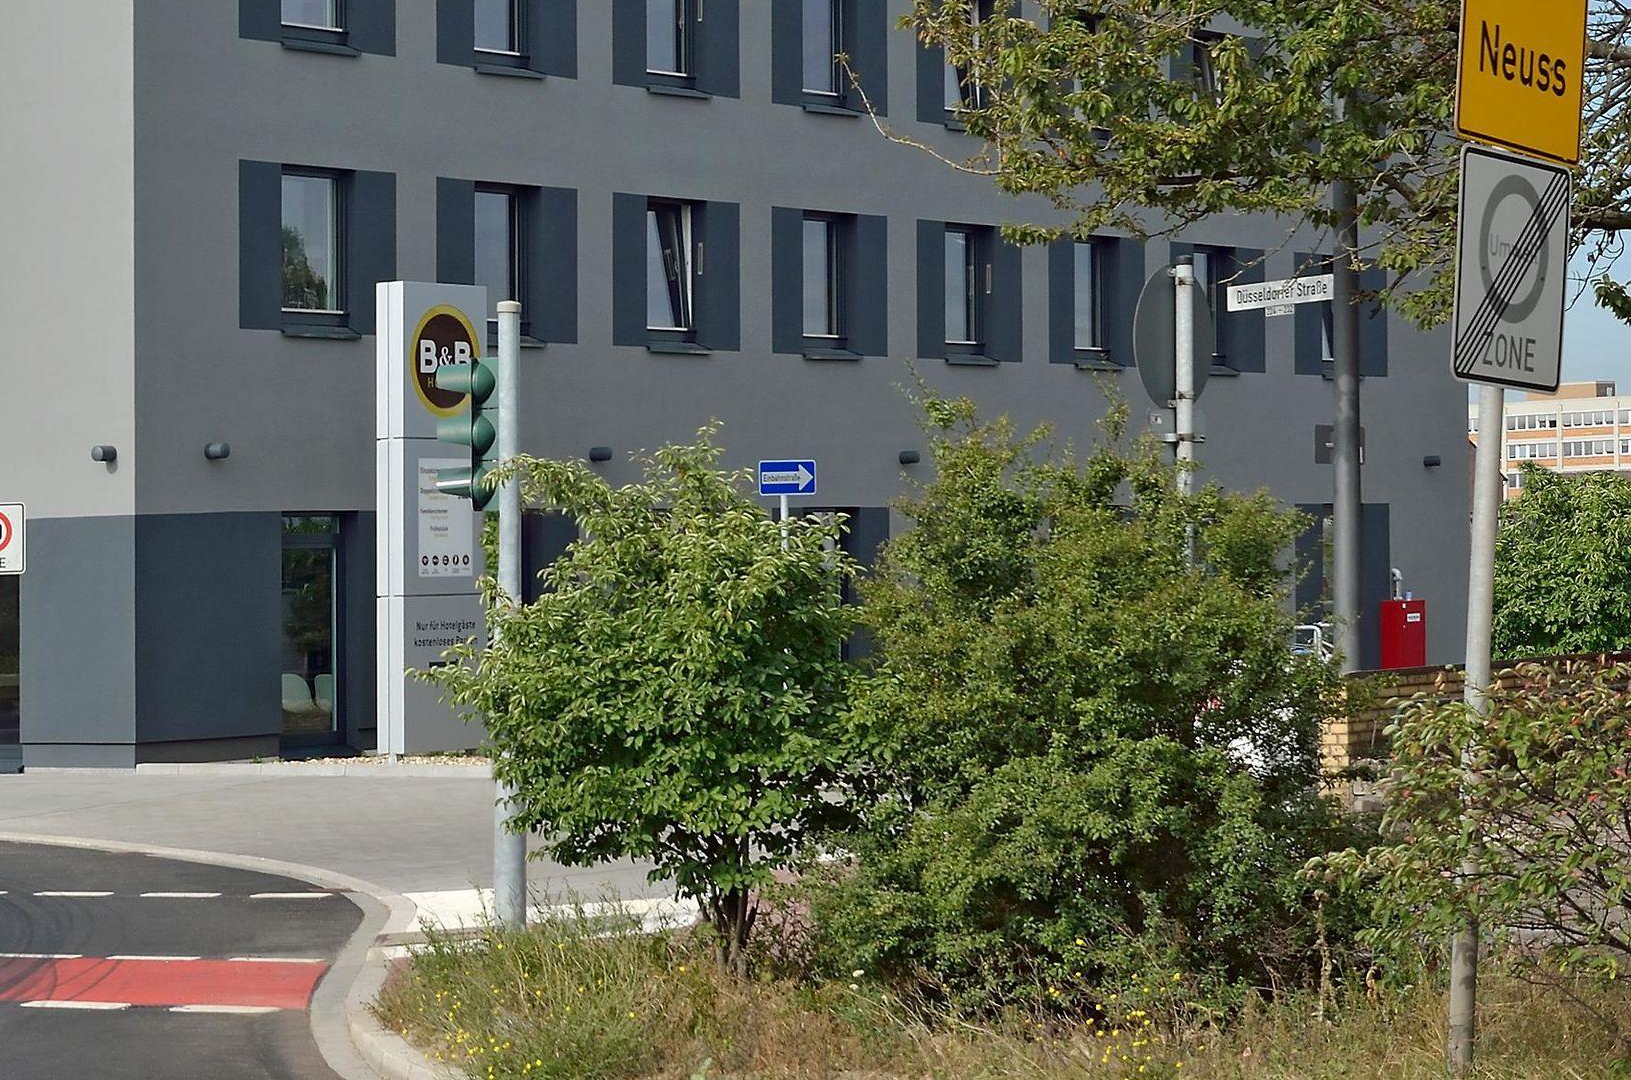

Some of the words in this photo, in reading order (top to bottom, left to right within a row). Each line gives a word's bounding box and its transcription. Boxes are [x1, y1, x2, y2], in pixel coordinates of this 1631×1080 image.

[1479, 20, 1567, 97] Neuss
[1236, 286, 1294, 304] Düsseldorfer
[1297, 280, 1328, 297] Straße
[420, 339, 471, 373] B&B
[1482, 331, 1537, 372] ZONE
[416, 621, 429, 631] Nur
[441, 619, 476, 633] Hotelgäste
